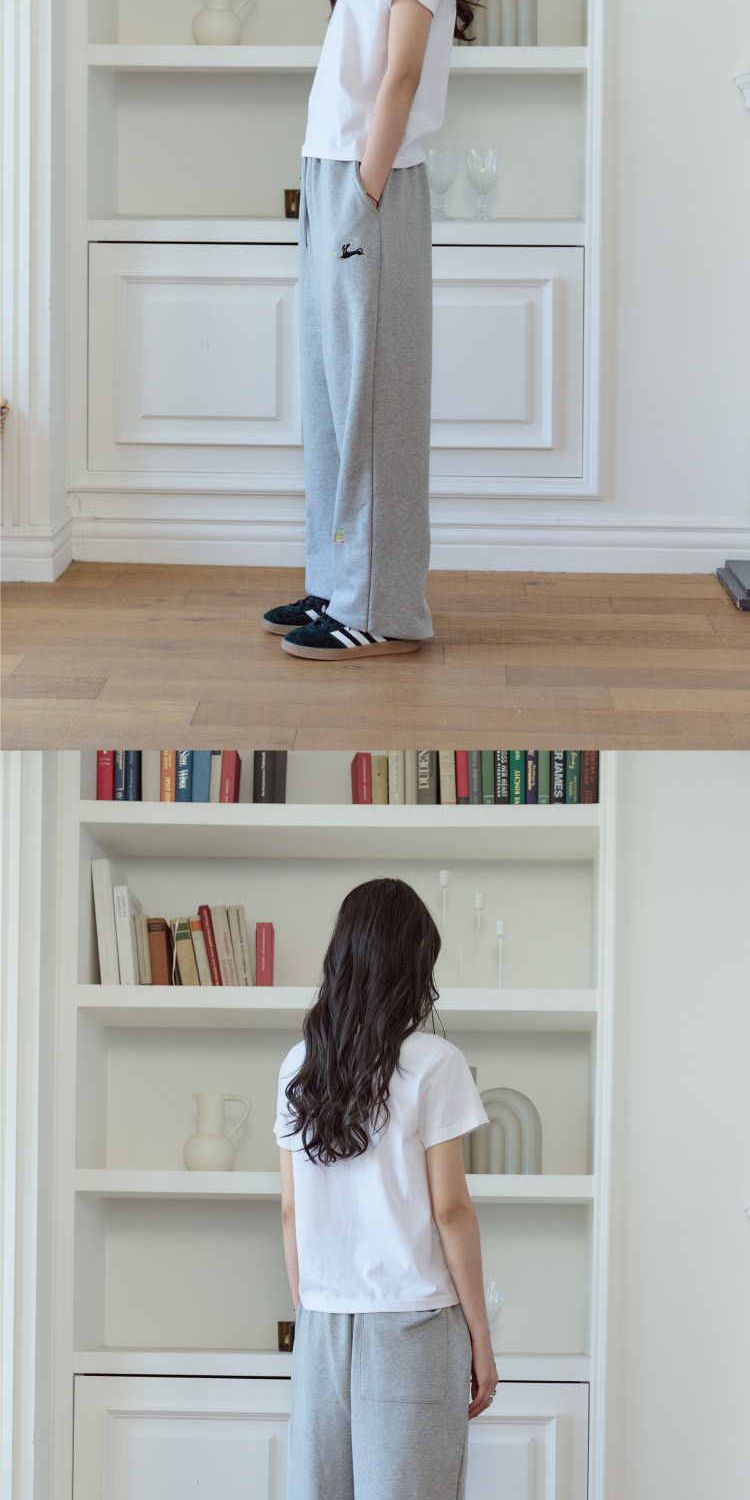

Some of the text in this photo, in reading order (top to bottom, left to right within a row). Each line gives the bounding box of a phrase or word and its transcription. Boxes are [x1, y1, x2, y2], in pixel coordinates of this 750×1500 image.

[178, 768, 188, 790] WINGS
[418, 750, 429, 789] DUDEN
[554, 761, 564, 798] JAMES
